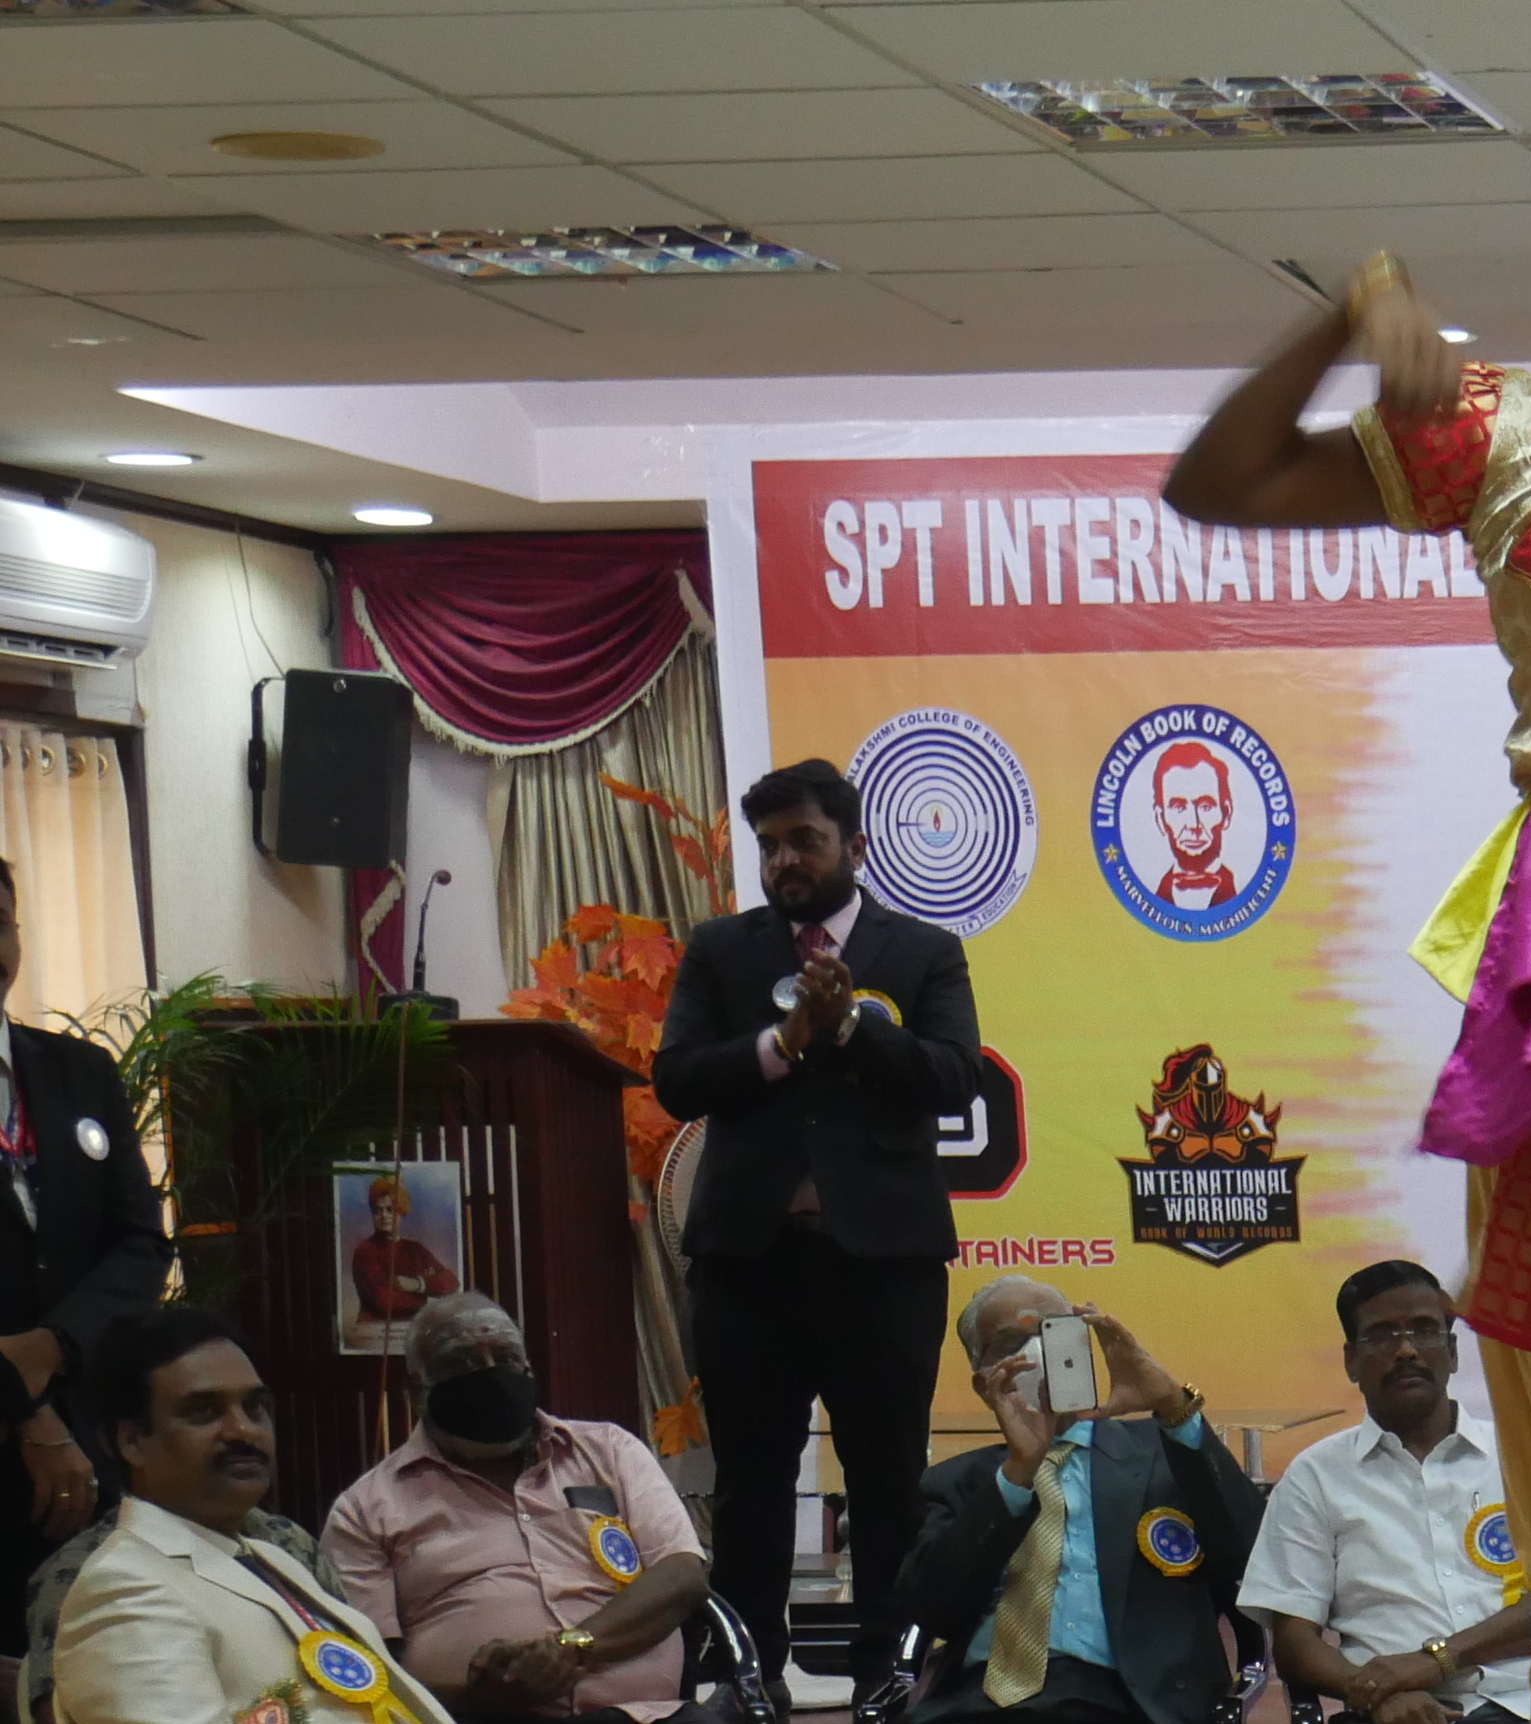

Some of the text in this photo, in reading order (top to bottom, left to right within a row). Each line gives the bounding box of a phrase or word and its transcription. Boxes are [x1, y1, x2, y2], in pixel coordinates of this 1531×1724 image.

[823, 499, 942, 610] SPT
[964, 497, 1486, 606] INTERNATIONAL
[898, 711, 960, 729] COLLEGE
[964, 718, 983, 734] OF
[983, 731, 1035, 828] ENGINEERING
[1097, 709, 1291, 828] LINCOLN BOOK OF RECORDS
[1133, 1168, 1292, 1198] INTERNATIONAL
[1163, 1197, 1268, 1225] WARRIORS
[946, 1236, 1116, 1269] TAINERS
